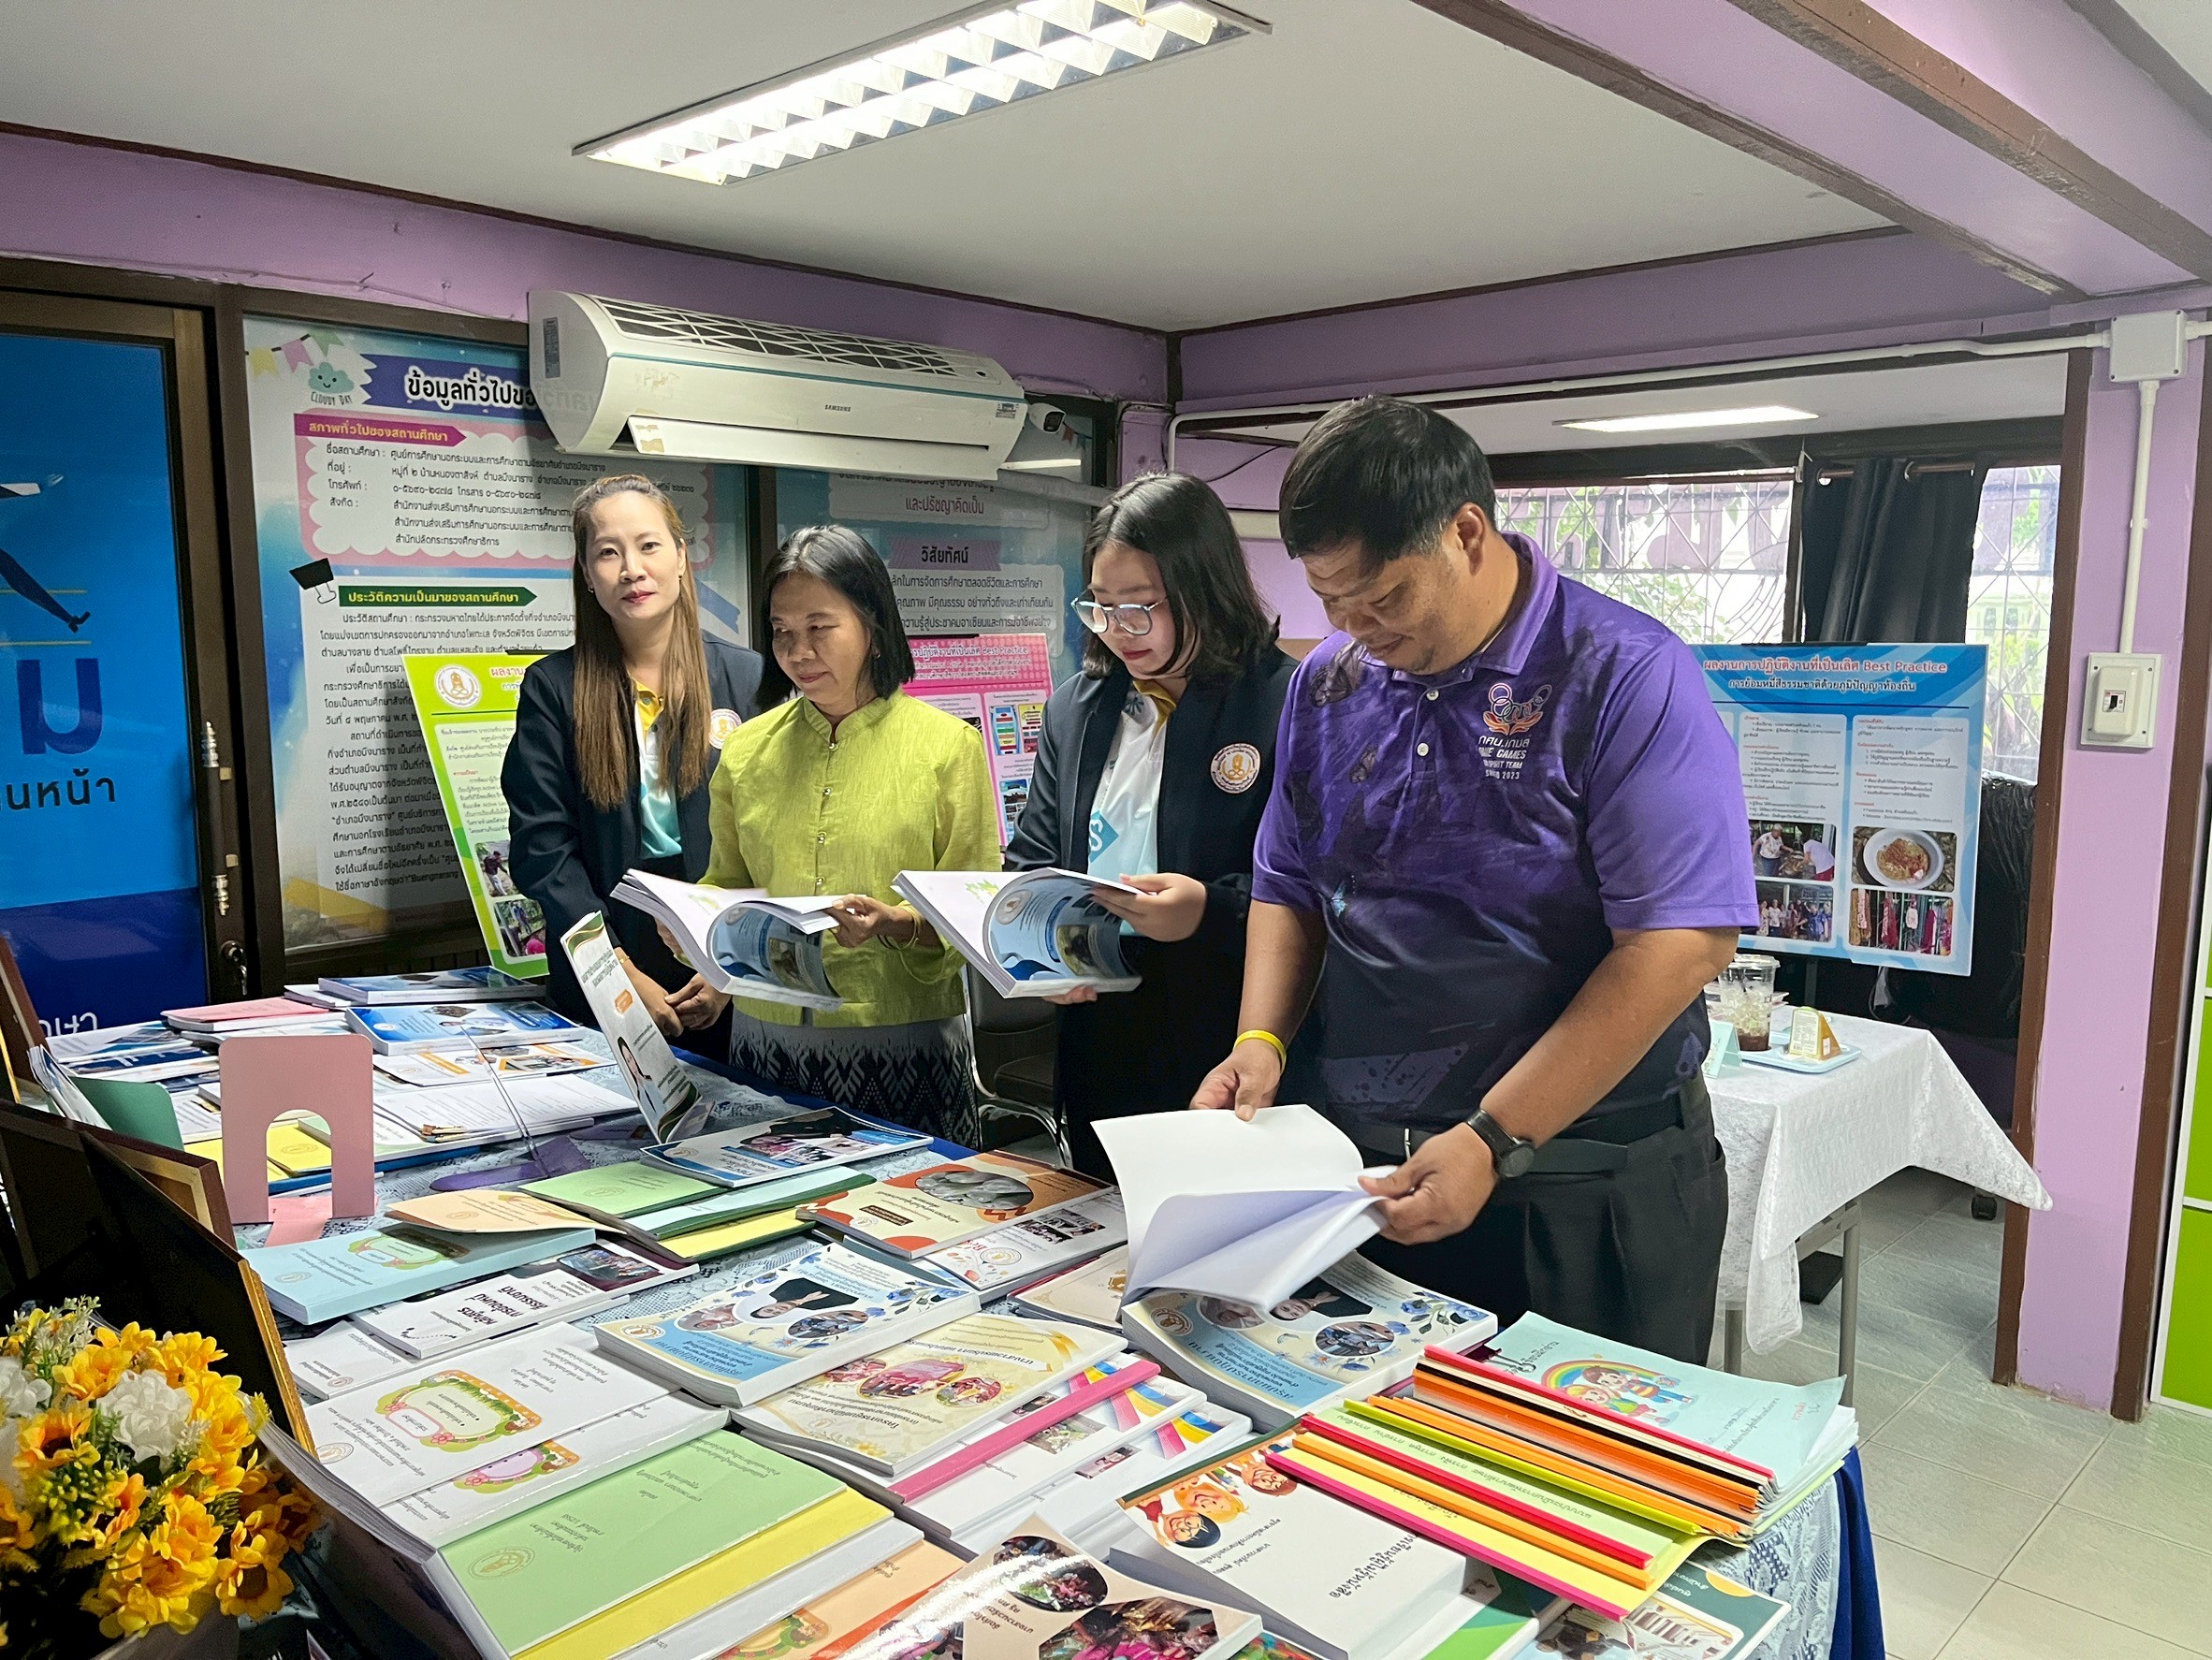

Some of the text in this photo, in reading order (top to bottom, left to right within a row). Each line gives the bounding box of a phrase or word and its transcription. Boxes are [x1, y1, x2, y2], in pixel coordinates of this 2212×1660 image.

[311, 391, 336, 406] CLOUDY
[824, 403, 851, 413] SAMSUNG
[309, 420, 447, 442] สภาพทั่วไปของสถานศึกษา
[327, 444, 380, 458] ชื่อสถานศึกษา
[327, 462, 345, 475] ที่อยู่
[328, 480, 362, 491] โทรศัพท์
[330, 498, 354, 507] สังกัด
[906, 496, 983, 514] และปรัชญาคิดเป็น
[396, 534, 500, 546] สำนักปลัดกระทรวงศึกษาธิการ
[921, 545, 969, 563] วิสัยทัศน์
[348, 590, 518, 603] ประวัติความเป็นมาของสถานศึกษา
[342, 613, 407, 623] ประวัติสถานศึกษา
[321, 647, 371, 657] ตำบลบางลาย
[983, 646, 998, 655] Best
[1000, 646, 1027, 655] Practice
[1704, 656, 1948, 674] ผลงานการปฏิบัติงานที่เป็นเลิศ Best Practice
[1728, 677, 1916, 692] การย้อมหมี่สีธรรมชาติด้วยภูมิปัญญาท้องถิ่น
[16, 658, 103, 754] ม
[1478, 735, 1532, 748] กศน.เกมส์
[1496, 749, 1528, 760] GAMES
[1505, 761, 1523, 769] TEAM
[492, 1286, 549, 1310] สีธรรมชาติ
[465, 1293, 524, 1318] การย้อมหมี่
[454, 1306, 499, 1326] หลักสูตร
[1184, 1340, 1295, 1400] สรุปผลการปฏิบัติงาน
